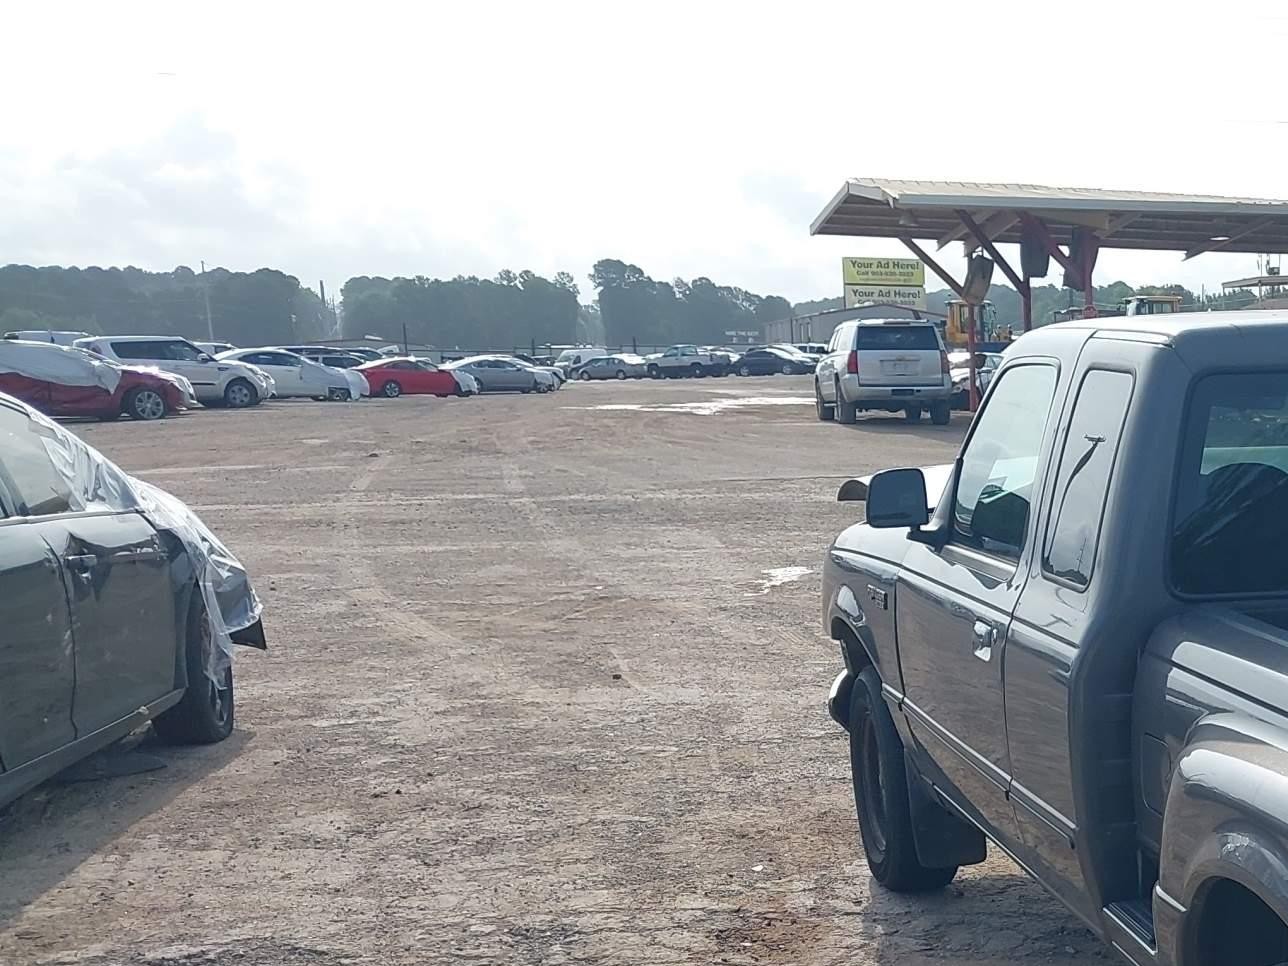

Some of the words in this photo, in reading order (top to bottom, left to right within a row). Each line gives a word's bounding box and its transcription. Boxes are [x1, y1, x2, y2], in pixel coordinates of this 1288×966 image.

[851, 260, 873, 269] Your
[876, 261, 889, 269] Ad
[893, 261, 919, 270] Here!
[852, 289, 874, 298] Your
[878, 290, 891, 298] Ad
[894, 290, 920, 299] Here!
